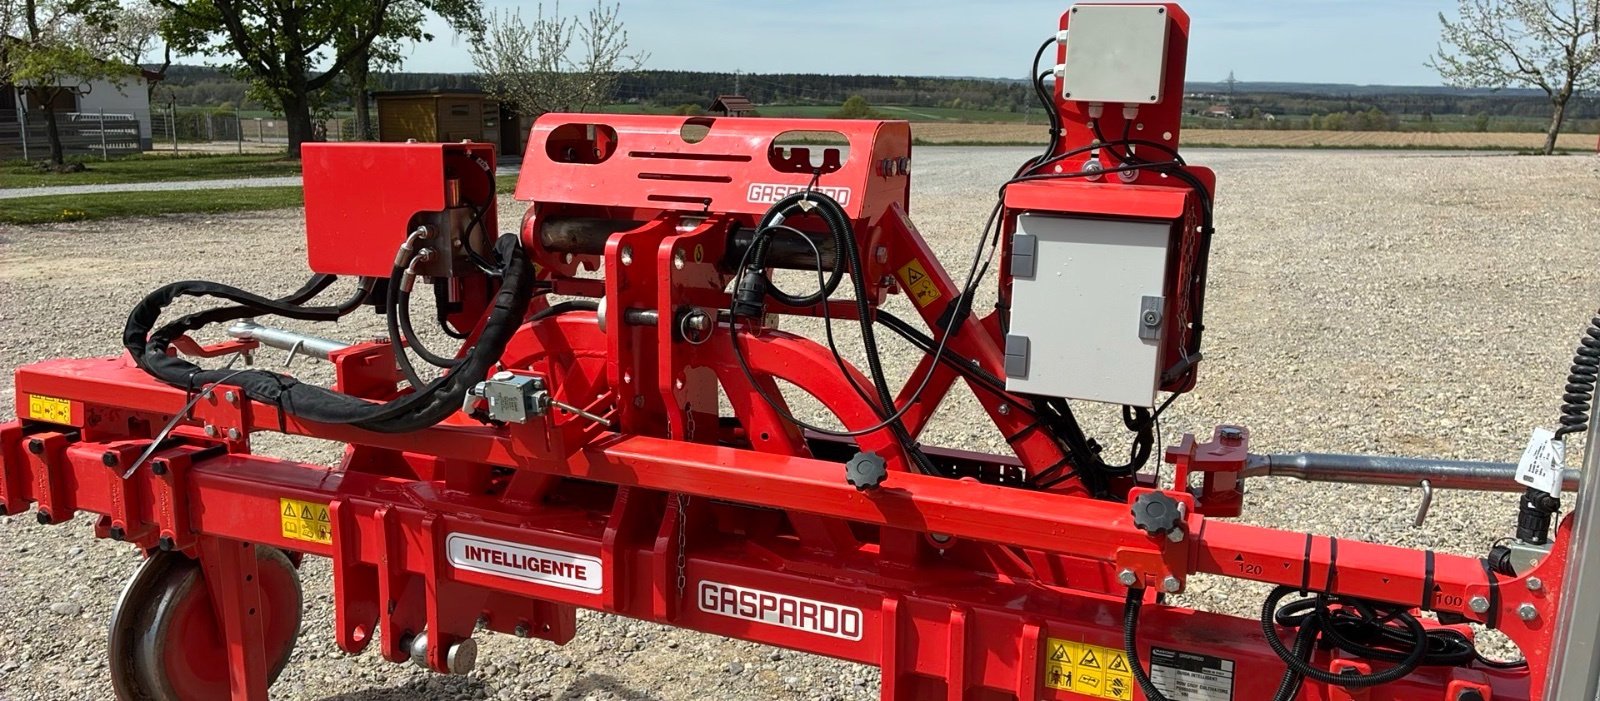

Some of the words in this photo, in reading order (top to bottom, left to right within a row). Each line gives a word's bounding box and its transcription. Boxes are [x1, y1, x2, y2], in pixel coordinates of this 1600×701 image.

[749, 185, 849, 205] GASO
[465, 545, 587, 581] INTELLIGENTE
[1239, 562, 1262, 575] 120
[1435, 593, 1463, 606] 100
[702, 583, 859, 638] GASPARDO
